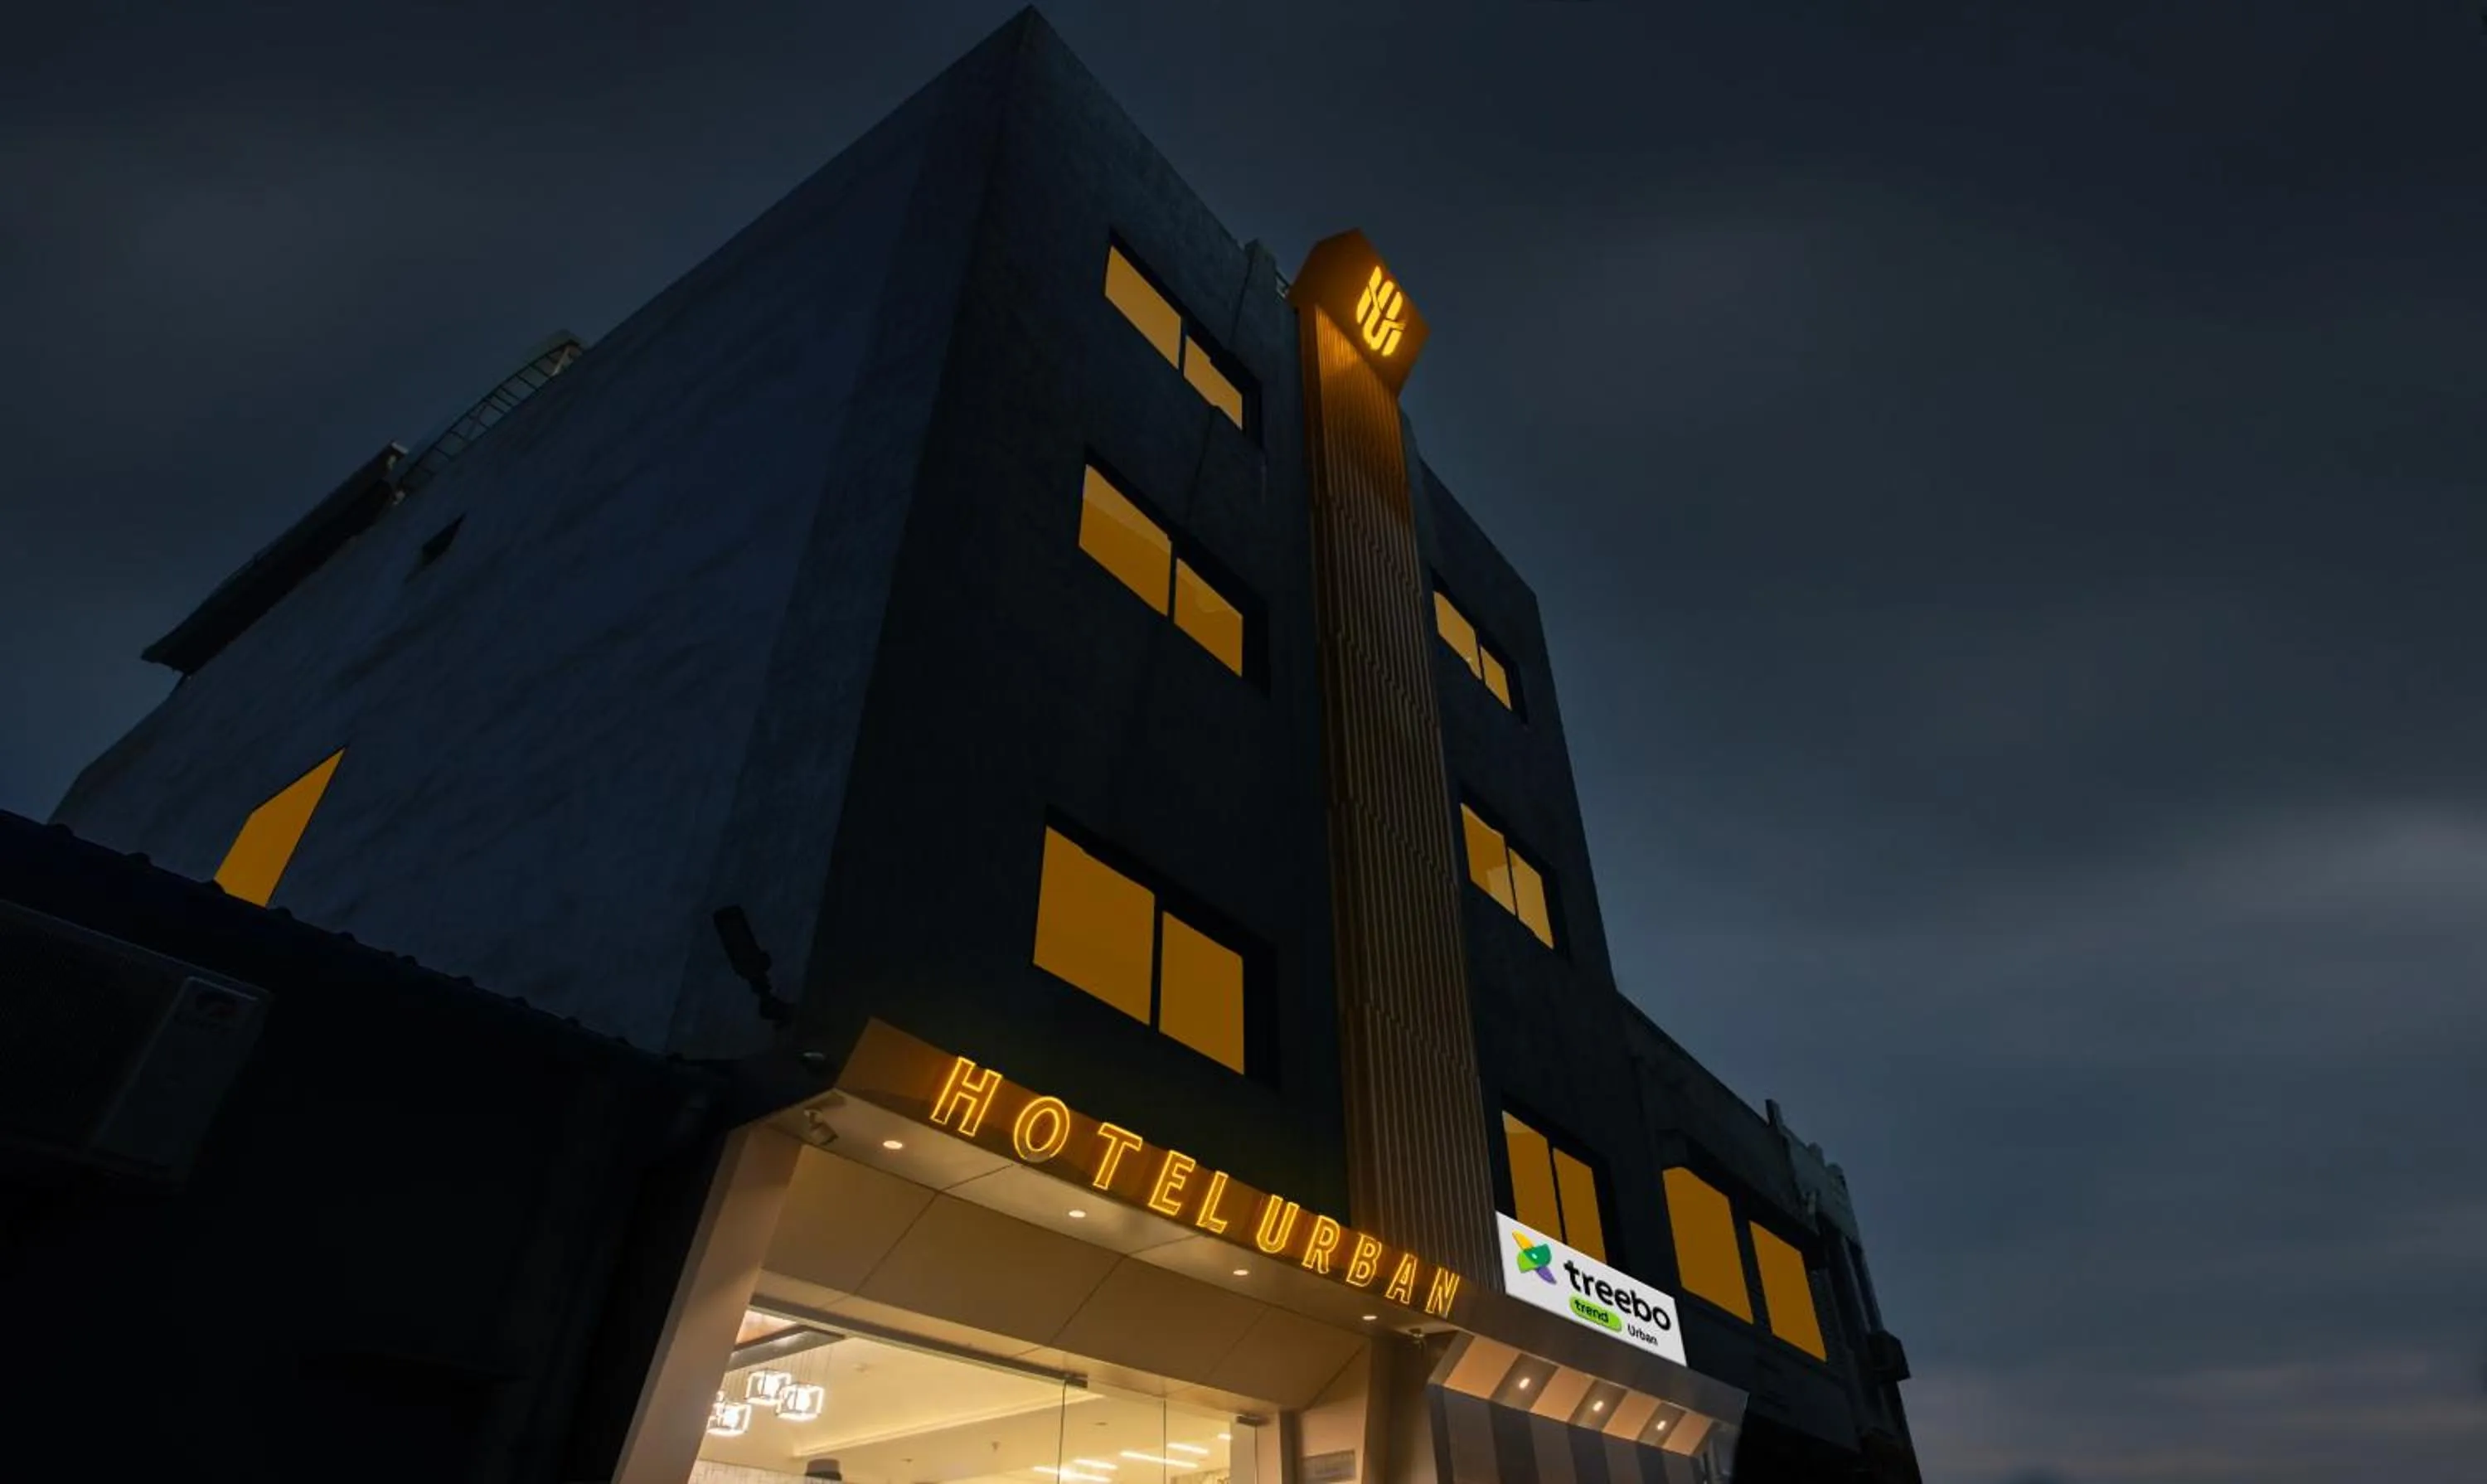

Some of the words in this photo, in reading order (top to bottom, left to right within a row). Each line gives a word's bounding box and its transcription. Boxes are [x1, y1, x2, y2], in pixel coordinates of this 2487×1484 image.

[930, 1056, 1229, 1234] HOTEL
[1256, 1195, 1460, 1318] URBAN
[1564, 1260, 1671, 1331] treebo
[1574, 1299, 1609, 1323] trend
[1627, 1324, 1659, 1346] Urban
